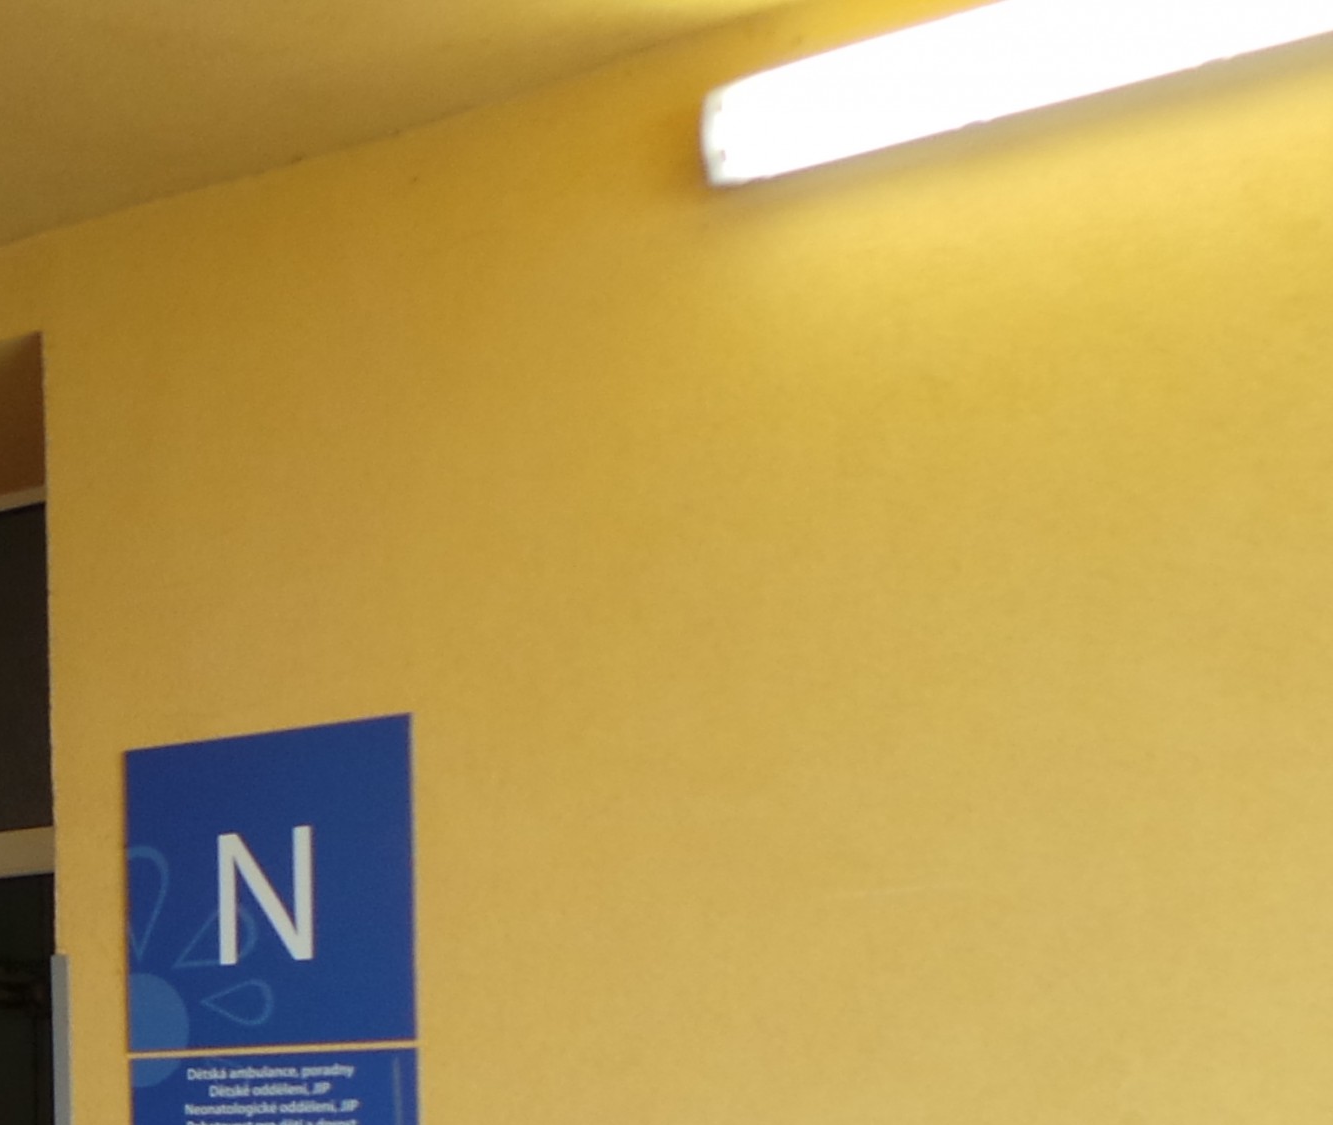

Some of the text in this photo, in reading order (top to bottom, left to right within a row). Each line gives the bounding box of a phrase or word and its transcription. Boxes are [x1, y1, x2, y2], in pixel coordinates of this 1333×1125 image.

[217, 824, 315, 966] N
[187, 1067, 227, 1081] Dětská
[300, 1063, 355, 1079] poradny
[209, 1083, 250, 1098] Dětské
[312, 1081, 331, 1095] JIP
[185, 1102, 277, 1117] Neonatologické
[340, 1098, 359, 1112] JIP
